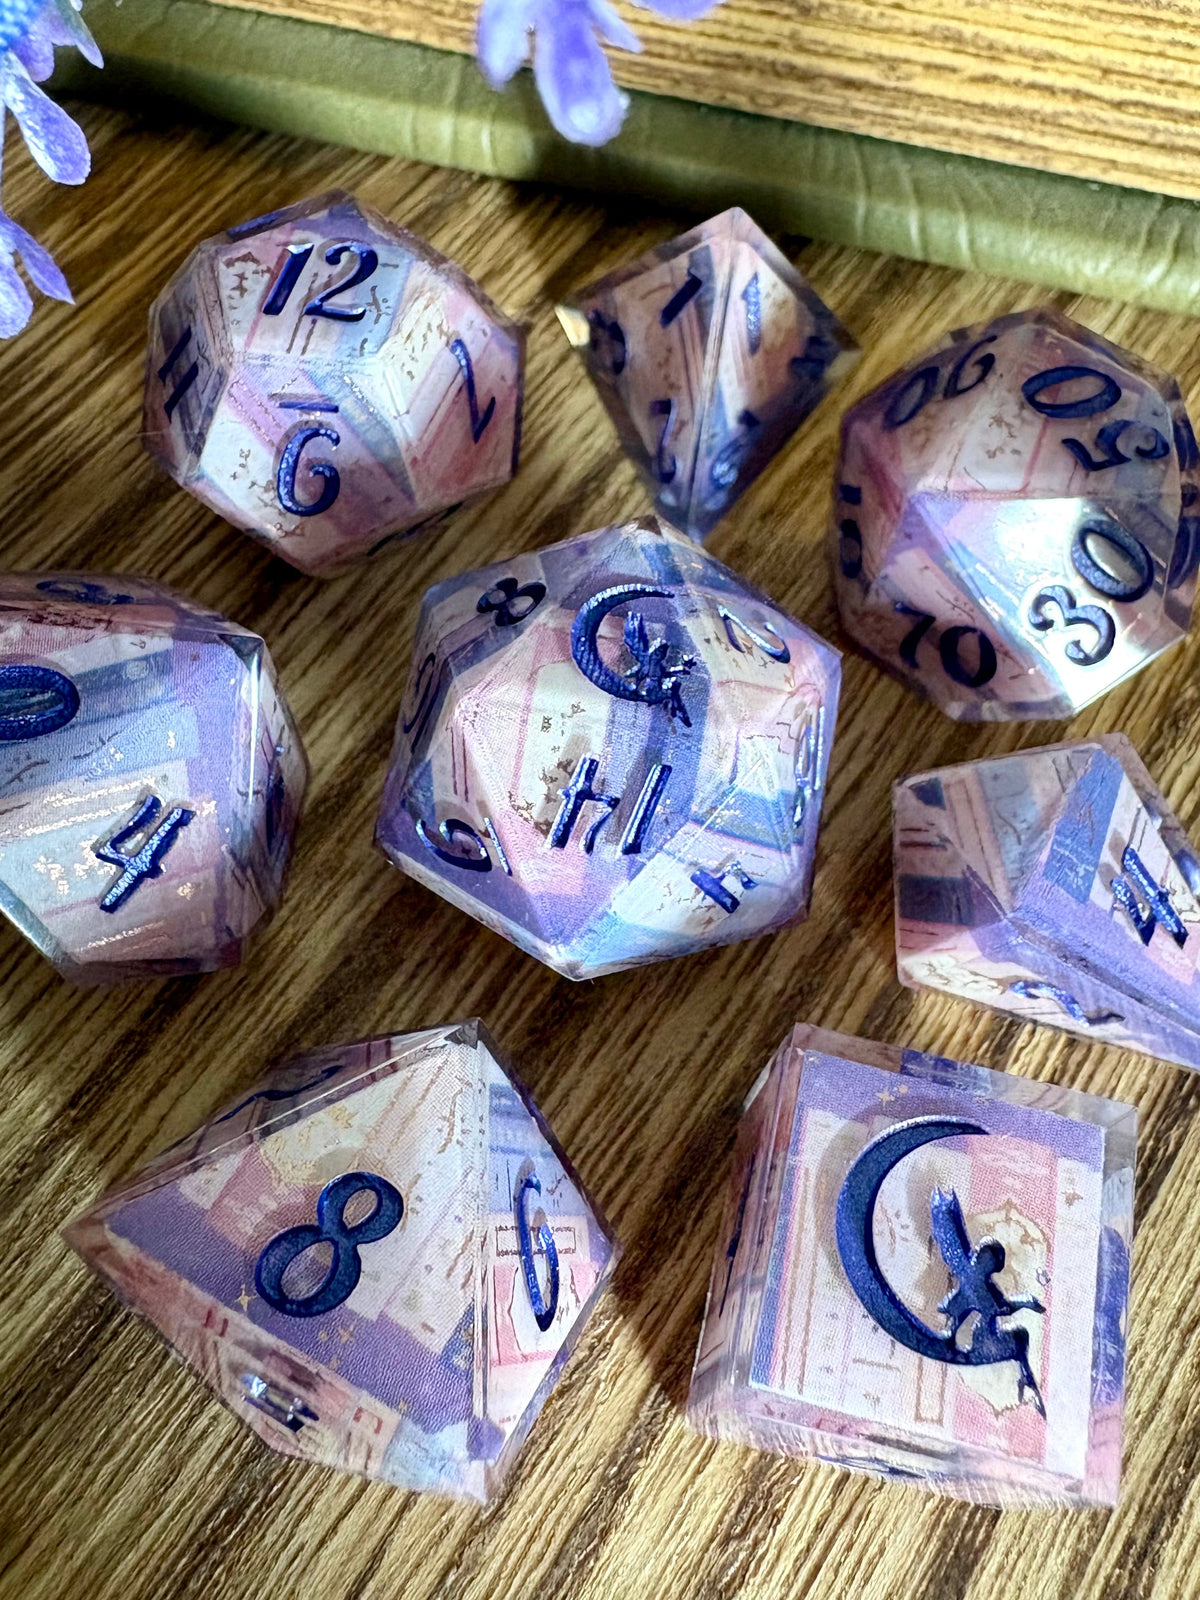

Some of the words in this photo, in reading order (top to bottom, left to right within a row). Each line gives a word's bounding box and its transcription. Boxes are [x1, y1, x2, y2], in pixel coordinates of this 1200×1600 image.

[263, 240, 379, 323] 12
[476, 577, 548, 627] 8
[1028, 518, 1154, 667] 30
[895, 600, 998, 689] 70
[96, 795, 195, 913] 4
[545, 752, 674, 855] 14
[255, 1171, 404, 1318] 8
